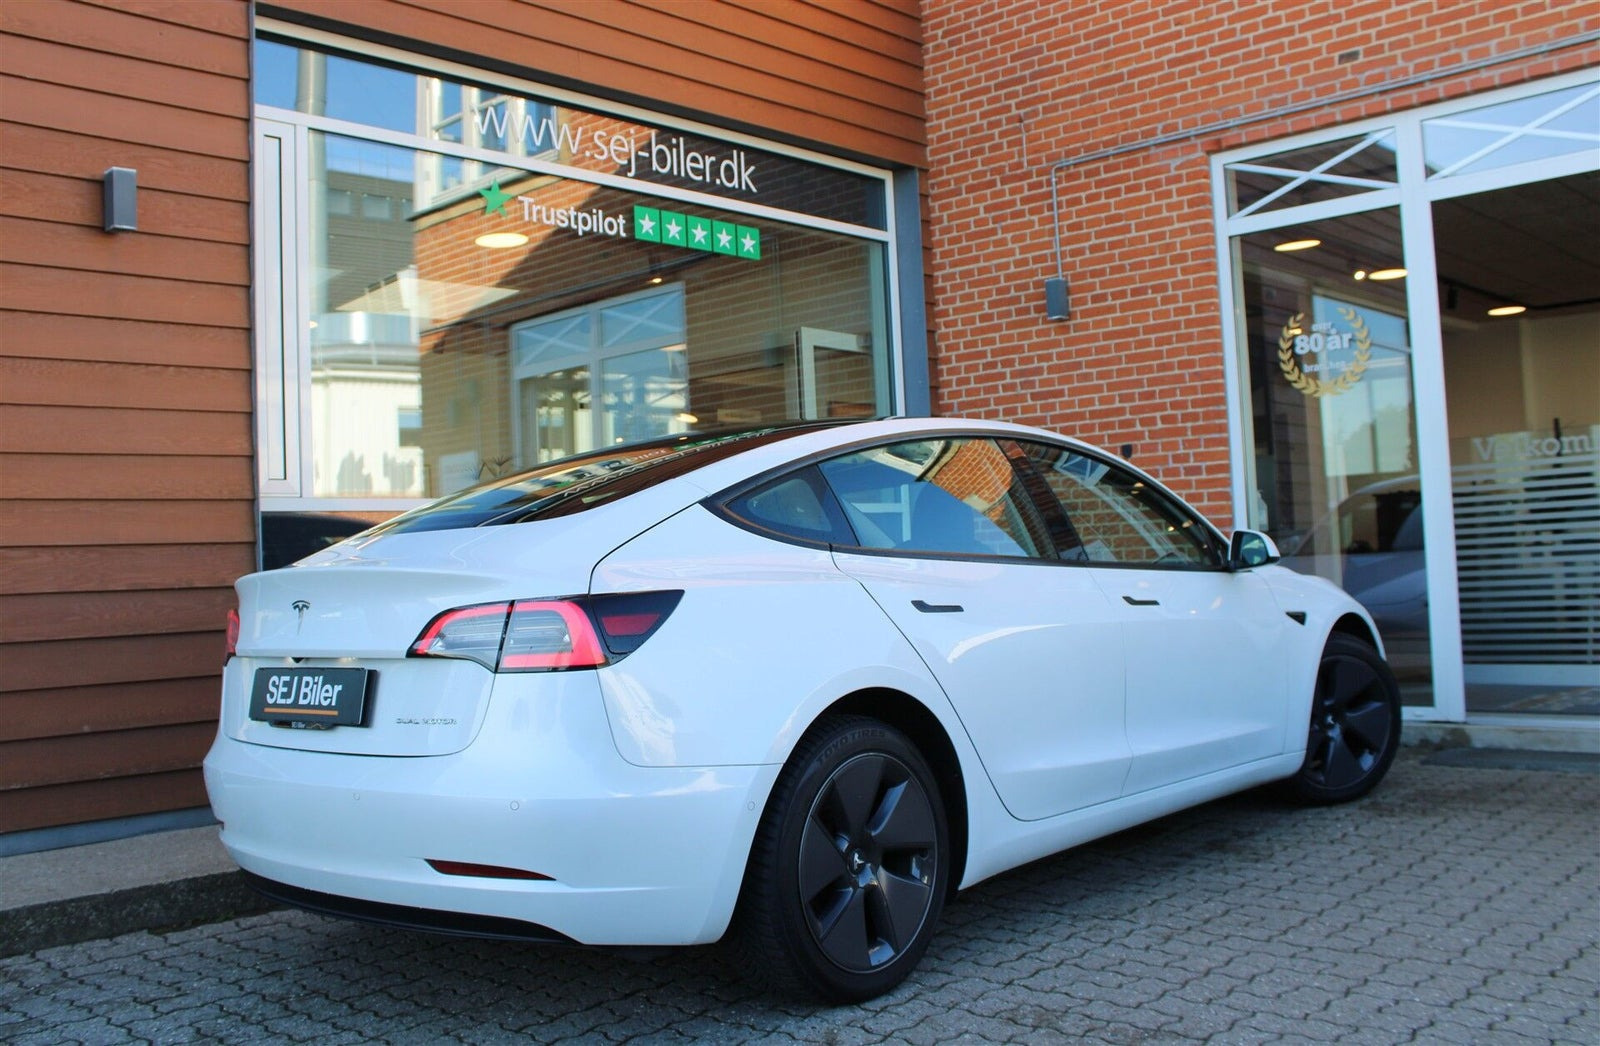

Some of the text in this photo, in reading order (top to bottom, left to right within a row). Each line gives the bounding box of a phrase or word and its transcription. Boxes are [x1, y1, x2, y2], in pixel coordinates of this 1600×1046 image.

[474, 105, 758, 193] www.sej-biler.dk
[517, 195, 627, 238] Trustpilot
[1294, 328, 1353, 355] 80 år
[266, 675, 343, 707] SEJ Biler
